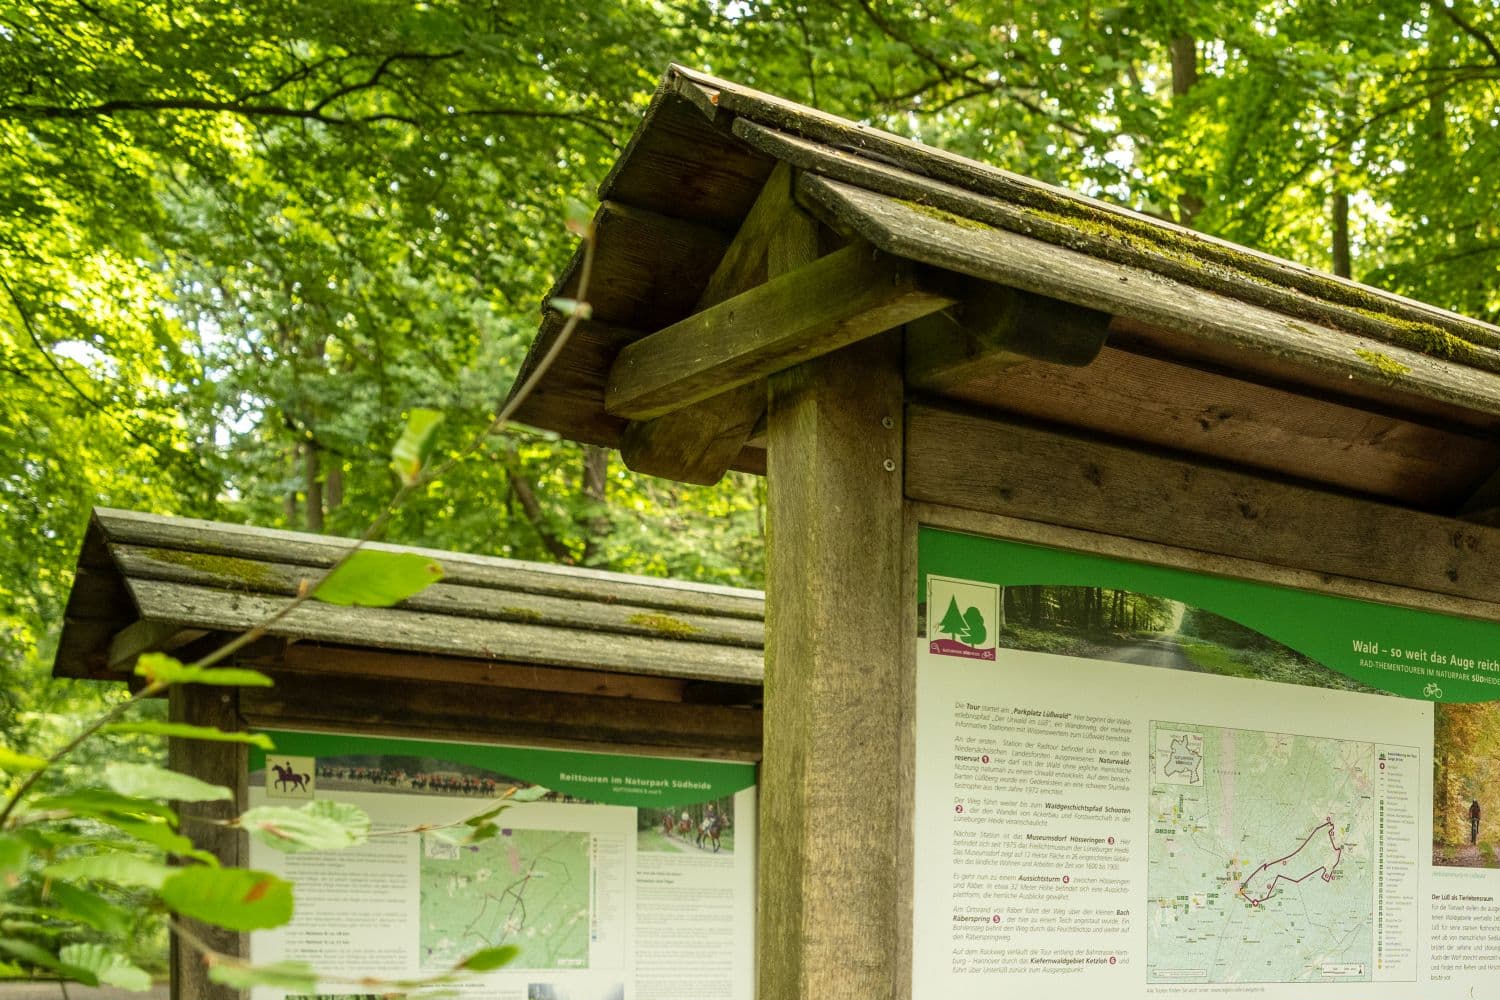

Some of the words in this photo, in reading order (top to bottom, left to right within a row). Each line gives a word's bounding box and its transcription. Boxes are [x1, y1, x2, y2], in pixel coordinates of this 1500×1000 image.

[1353, 640, 1378, 654] Wald
[1391, 648, 1402, 658] so
[1406, 649, 1426, 661] weit
[1431, 652, 1447, 664] das
[1450, 655, 1474, 670] Auge
[1360, 659, 1425, 675] RAD-THEMENTOUREN
[1427, 668, 1434, 676] IM
[1436, 670, 1469, 681] NATURPARK
[1472, 675, 1500, 685] SÜDHEIDE
[560, 773, 608, 783] Reittouren
[611, 776, 622, 784] im
[625, 777, 669, 787] Naturpark
[672, 780, 712, 790] Südheide
